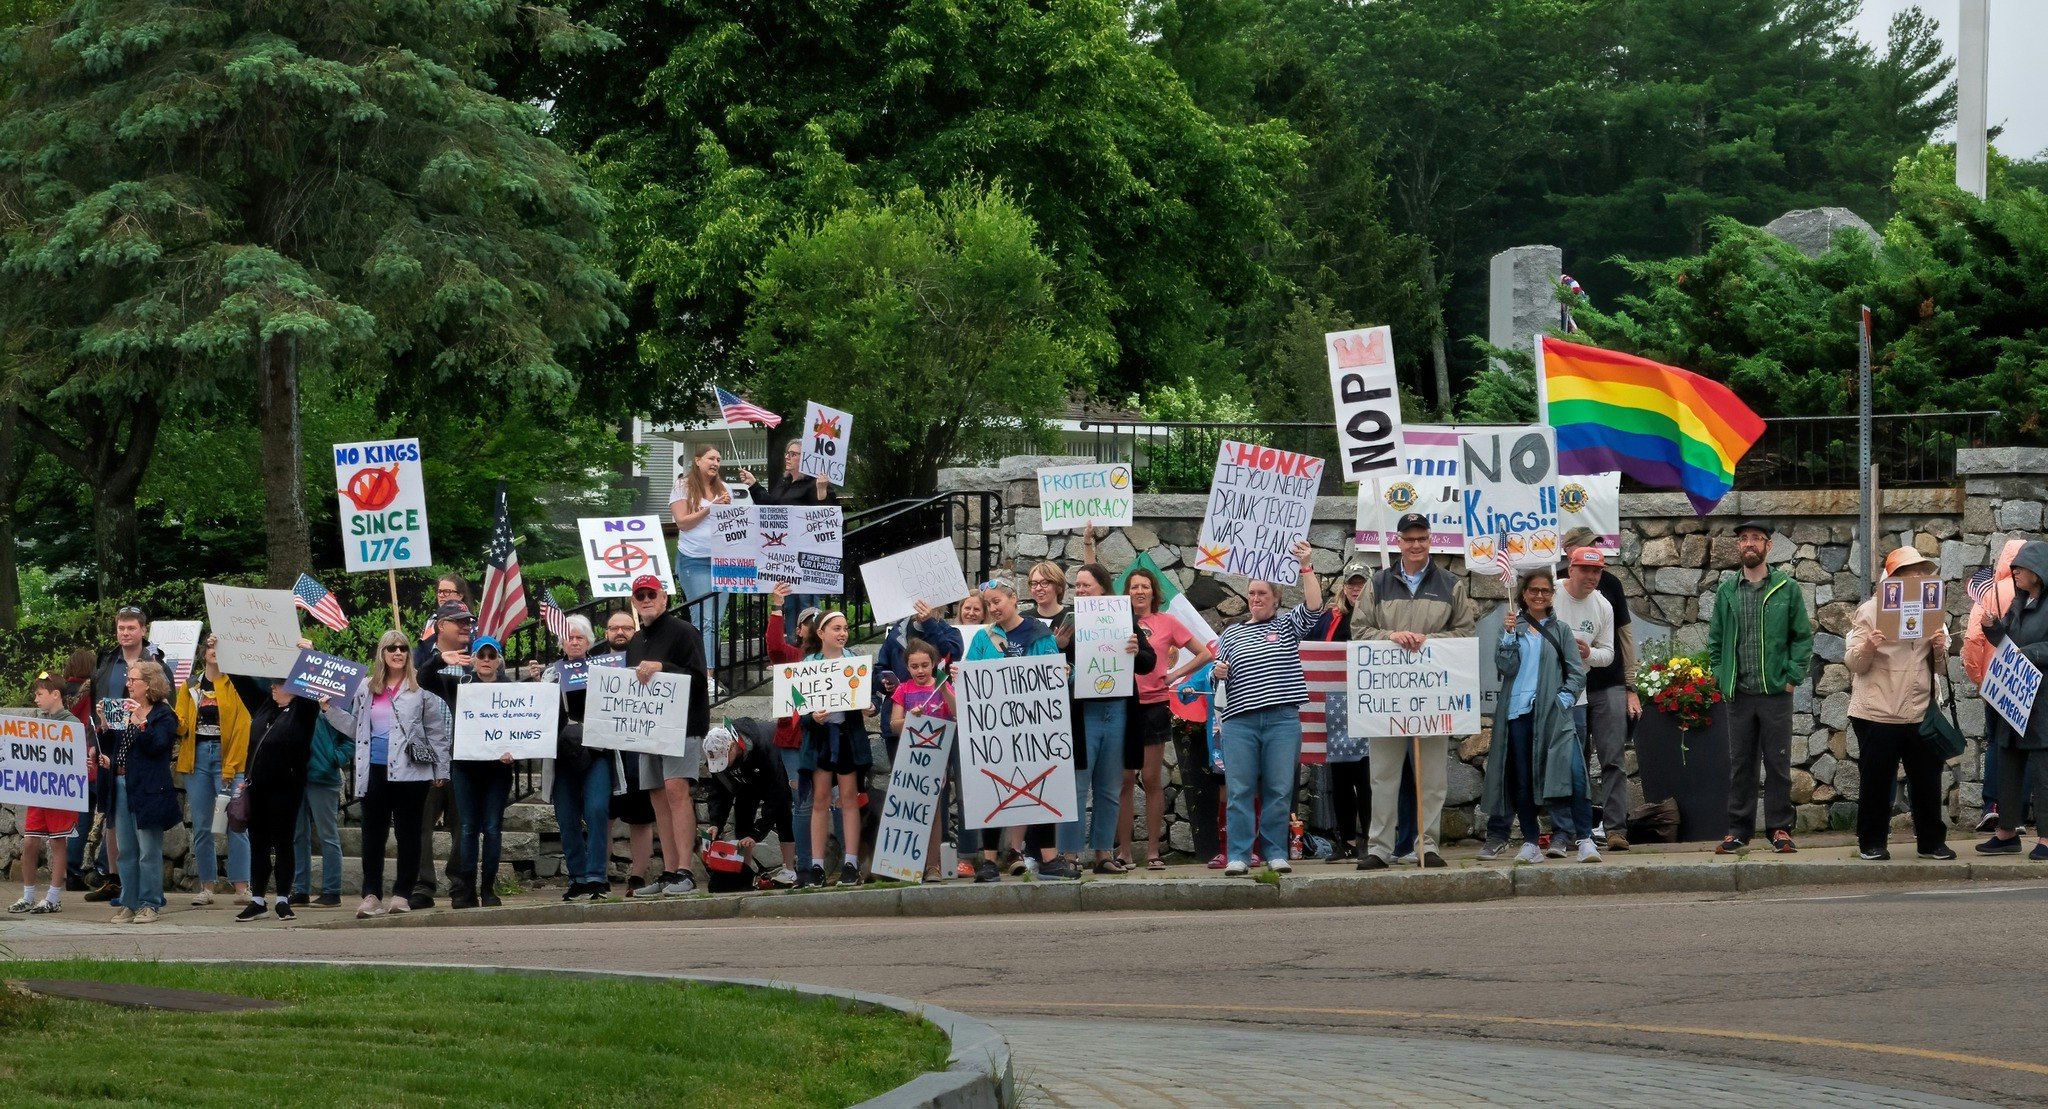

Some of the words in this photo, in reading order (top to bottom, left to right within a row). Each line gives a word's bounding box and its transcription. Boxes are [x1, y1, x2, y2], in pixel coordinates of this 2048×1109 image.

[336, 448, 359, 466] NO
[364, 443, 419, 463] KINGS
[814, 438, 836, 456] NO
[801, 452, 844, 481] KINGS
[1463, 432, 1551, 485] NO
[1040, 470, 1107, 493] PROTECT
[1218, 463, 1245, 485] IF
[1246, 467, 1271, 491] YOU
[1273, 475, 1314, 499] NEVER
[716, 507, 745, 520] HANDS
[805, 507, 835, 520] HANDS
[1044, 498, 1129, 521] DEMOCRACY
[1212, 488, 1264, 522] DRUNK
[1262, 497, 1306, 528] TEXTED
[351, 509, 420, 536] SINCE
[604, 519, 646, 532] NO
[718, 521, 733, 532] OFF
[737, 518, 748, 528] MY
[806, 522, 822, 532] OFF
[825, 518, 839, 529] MY
[725, 530, 747, 542] BODY
[814, 531, 836, 542] VOTE
[1211, 516, 1245, 545] WAR
[1254, 524, 1302, 555] PLANS
[360, 536, 410, 562] 1776
[768, 552, 795, 562] HANDS
[714, 558, 728, 566] THIS
[737, 559, 755, 567] WHAT
[765, 562, 778, 571] OFF
[783, 564, 795, 573] MY
[896, 543, 949, 578] KINGS
[1227, 546, 1256, 574] NO
[1253, 550, 1299, 584] KINGS
[714, 577, 737, 585] LOOKS
[739, 577, 755, 585] LIKE
[758, 571, 802, 585] IMMIGRANT
[902, 565, 957, 593] CROWN
[208, 587, 234, 607] We
[246, 593, 276, 613] the
[1077, 599, 1129, 613] LIBERTY
[230, 615, 268, 629] people
[1096, 615, 1115, 624] AND
[268, 632, 294, 648] ALL
[1076, 627, 1129, 642] JUSTICE
[1098, 644, 1117, 653] FOR
[1357, 645, 1431, 666] DECENCY!
[240, 652, 277, 668] people
[306, 655, 322, 665] NO
[324, 660, 358, 676] KINGS
[586, 655, 623, 666] KINGS
[1087, 657, 1125, 674] ALL
[2002, 643, 2015, 665] NO
[2013, 653, 2040, 691] KINGS
[298, 672, 346, 692] AMERICA
[321, 668, 334, 678] IN
[963, 669, 993, 702] NO
[997, 664, 1065, 695] THRONES
[1357, 669, 1448, 690] DEMOCRACY!
[1989, 657, 2002, 678] NO
[2001, 667, 2034, 709] FACISTS
[600, 675, 620, 693] NO
[628, 678, 676, 703] KINGS!
[800, 677, 833, 695] LIES
[601, 696, 663, 715] IMPEACH
[1358, 693, 1401, 713] RULE
[1410, 697, 1427, 711] OF
[1438, 694, 1471, 712] LAW!
[1984, 679, 1999, 700] IN
[1997, 694, 2027, 732] AMERICA
[502, 710, 541, 720] democracy
[967, 703, 997, 733] NO
[1000, 698, 1062, 727] CROWNS
[1390, 714, 1452, 735] NOW!!!
[0, 720, 73, 742] MERICA
[484, 729, 503, 741] NO
[509, 730, 542, 740] KINGS
[612, 716, 656, 736] TRUMP
[11, 743, 46, 762] RUNS
[54, 747, 73, 765] ON
[909, 751, 931, 767] NO
[970, 735, 1003, 766] NO
[1012, 732, 1072, 763] KINGS
[892, 769, 941, 796] KINGS
[884, 794, 931, 826] SINCE
[883, 826, 922, 861] 1776
